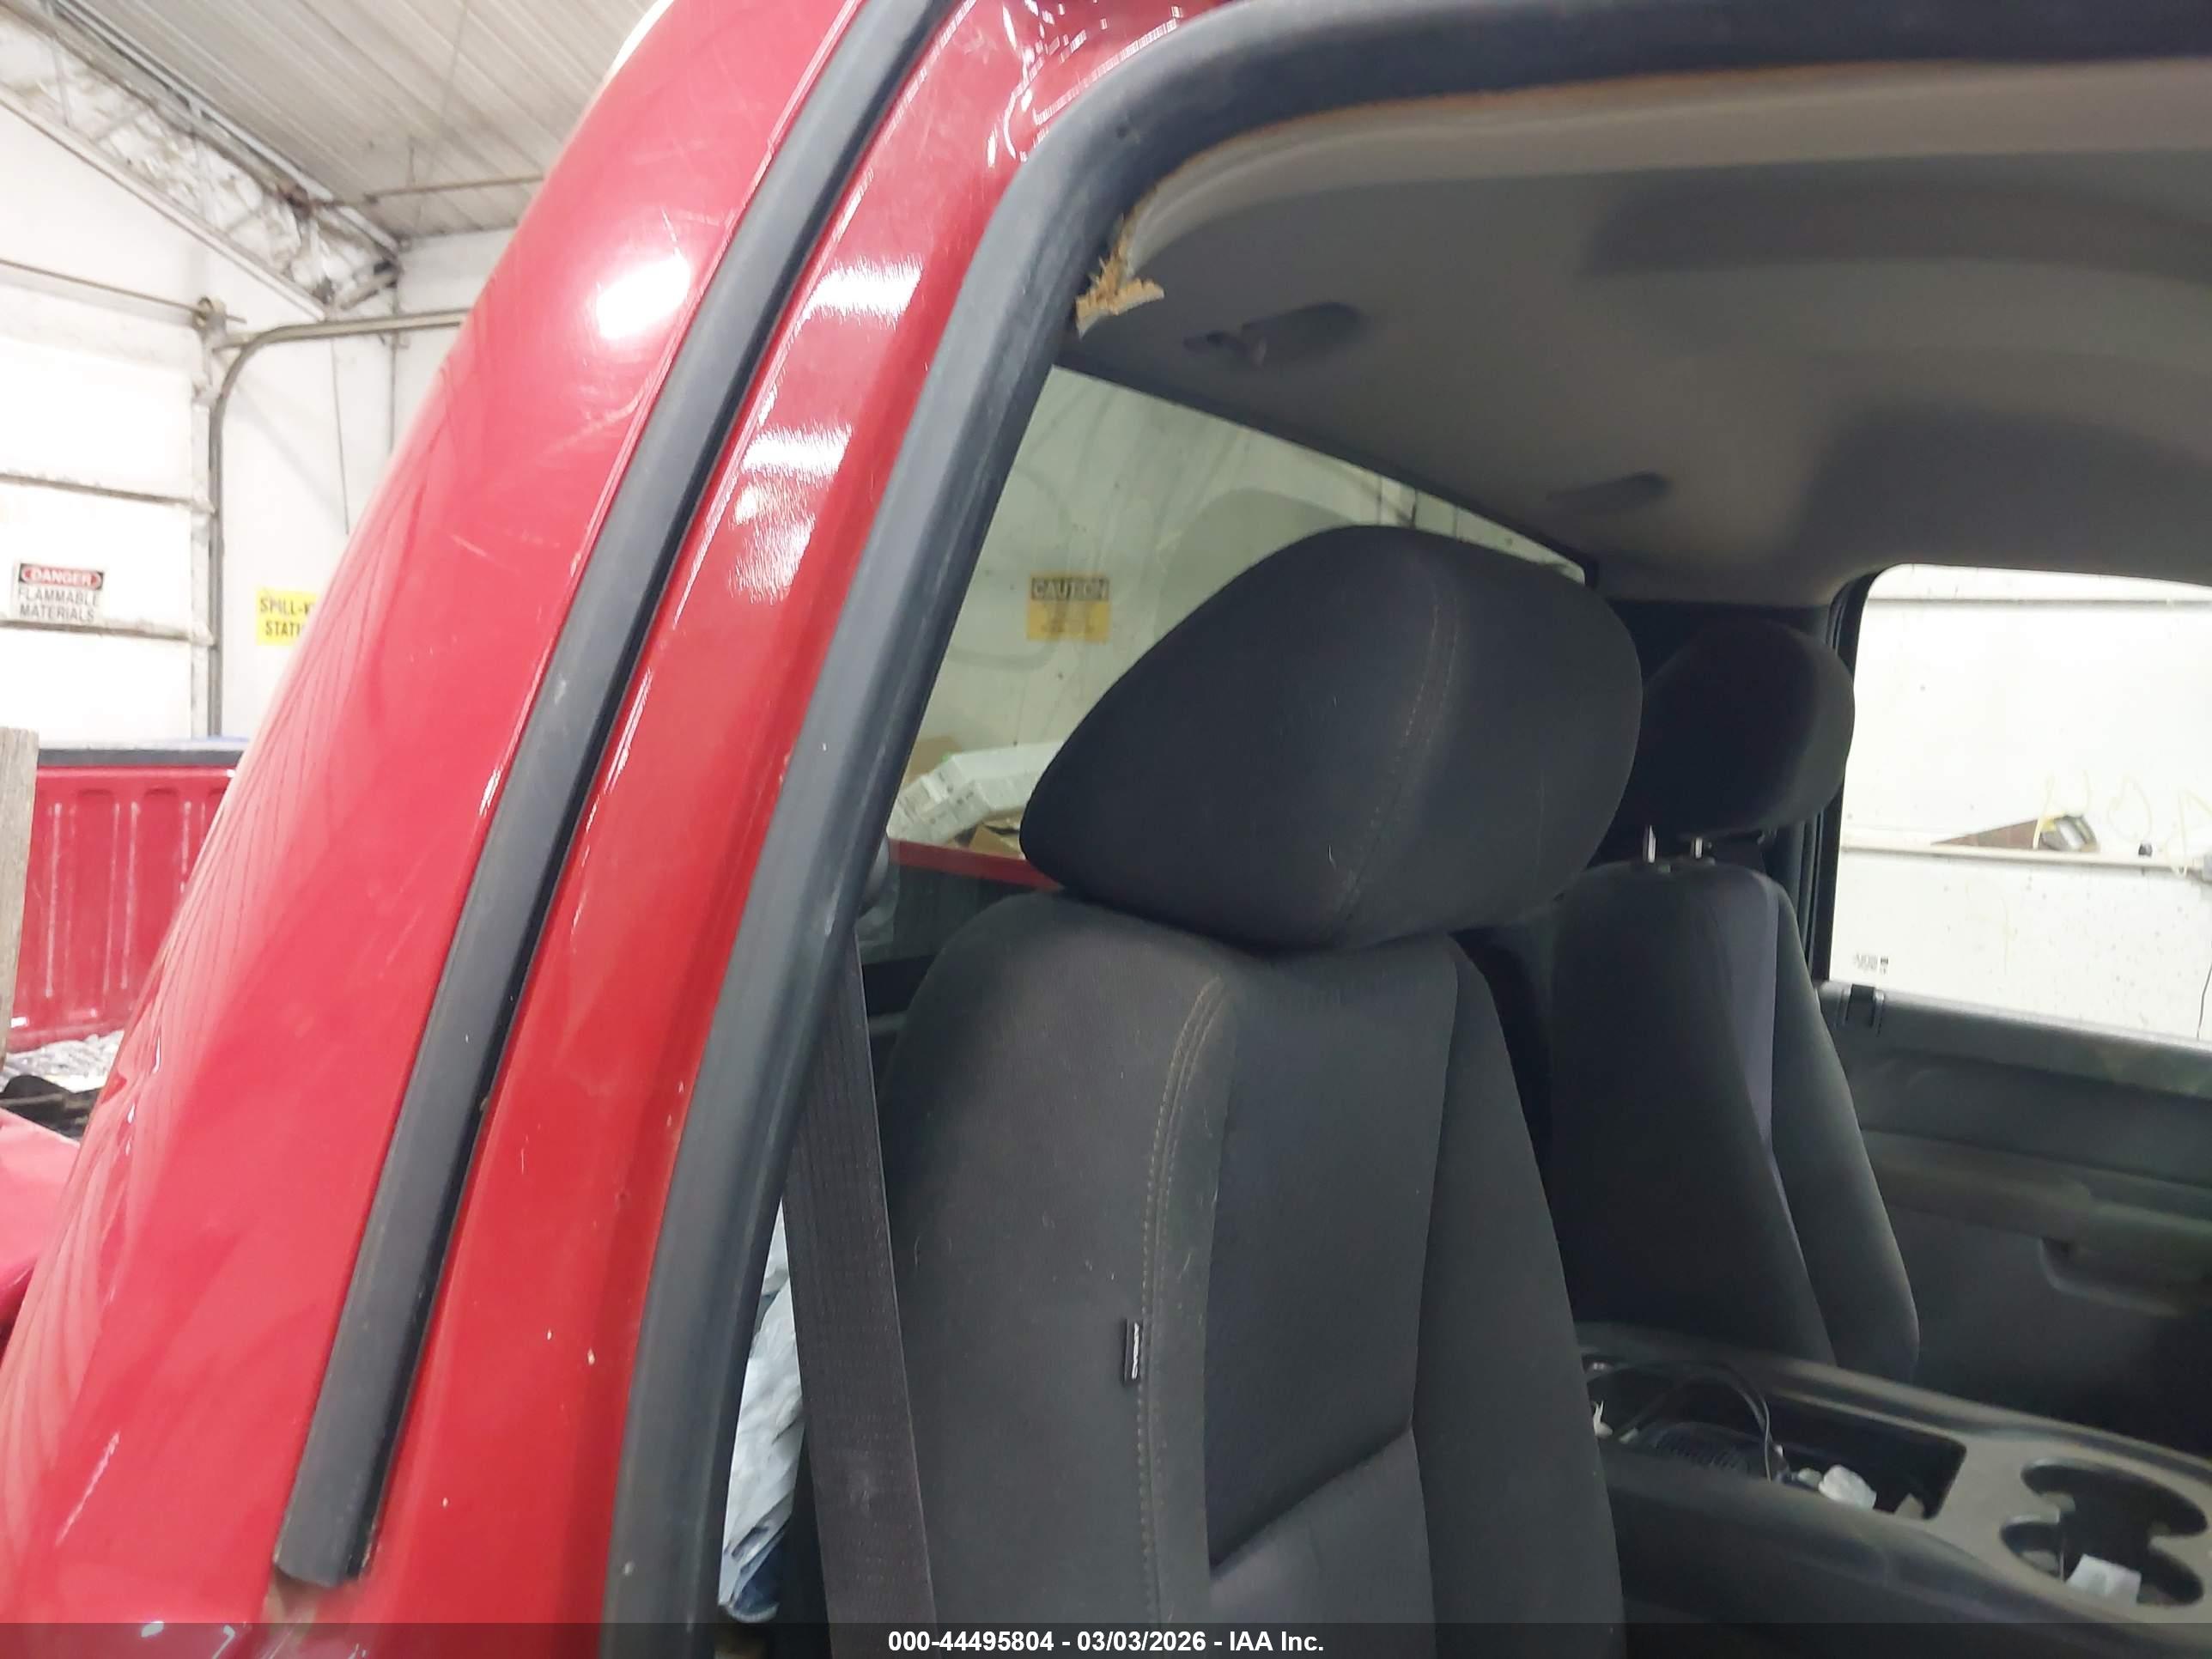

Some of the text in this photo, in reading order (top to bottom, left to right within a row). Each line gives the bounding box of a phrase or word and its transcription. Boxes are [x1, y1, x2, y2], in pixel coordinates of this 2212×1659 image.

[31, 568, 92, 586] DANGER
[18, 586, 99, 605] FLAMMABLE
[1031, 579, 1109, 600] CAUTION
[20, 603, 94, 623] MATERIALS
[265, 619, 305, 637] STATI
